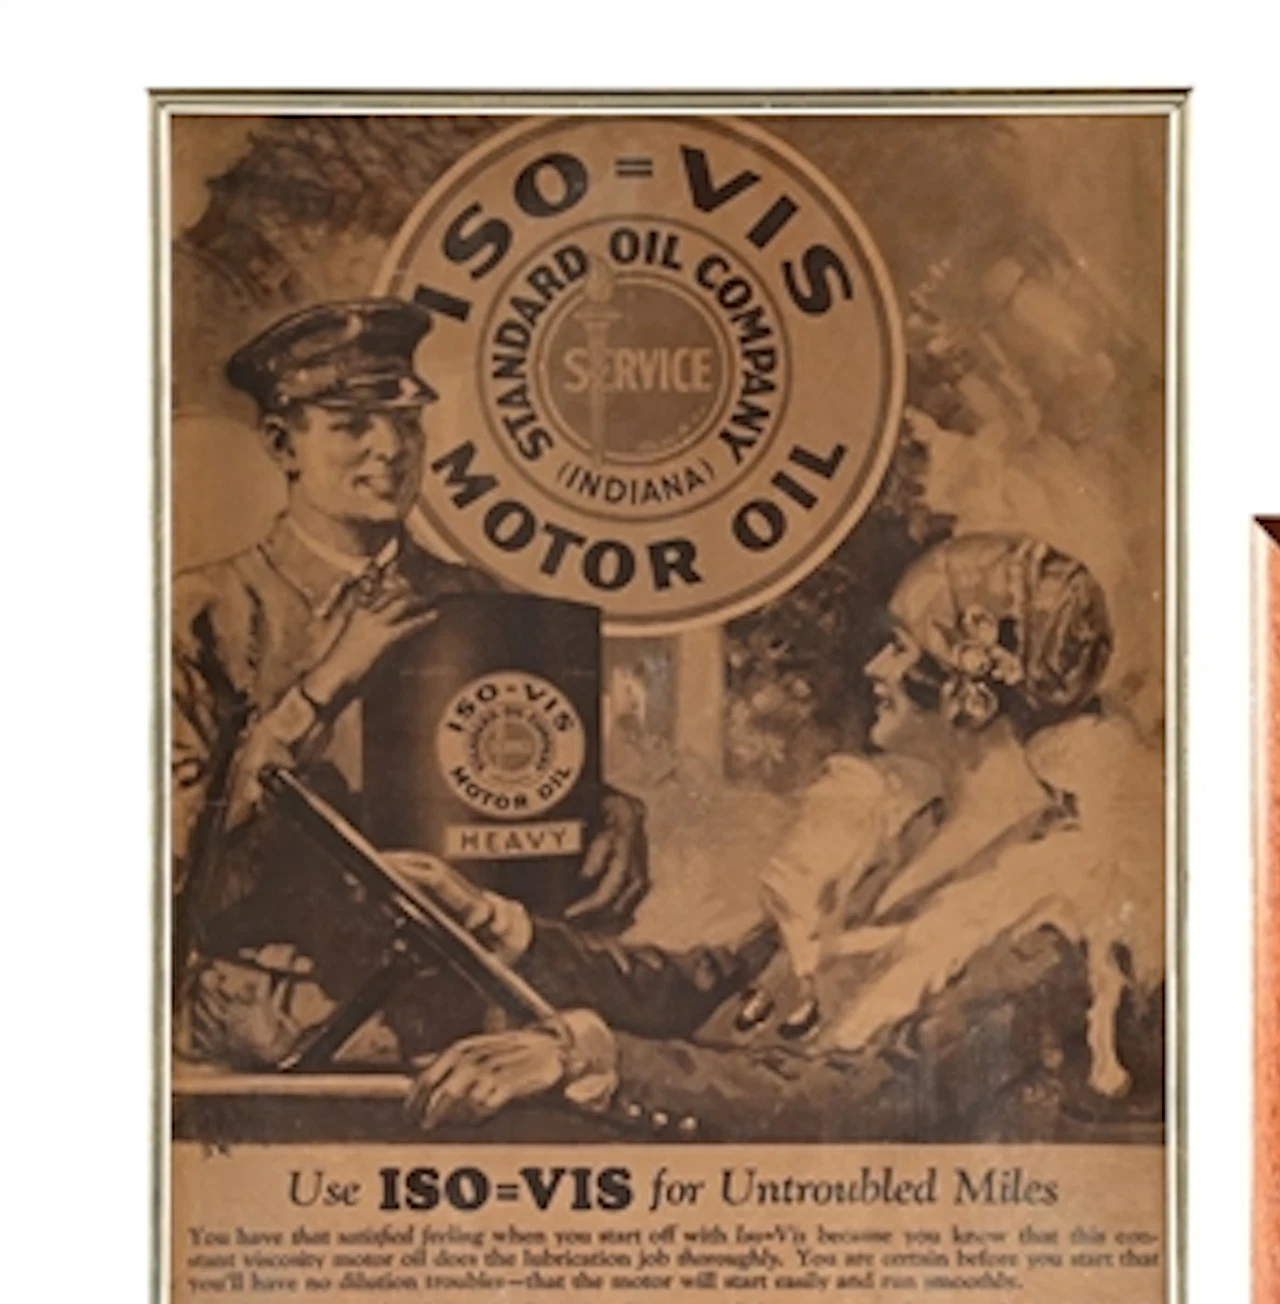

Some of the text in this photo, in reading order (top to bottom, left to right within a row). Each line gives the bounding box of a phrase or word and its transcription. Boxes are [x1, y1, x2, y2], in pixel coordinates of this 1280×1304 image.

[492, 228, 777, 465] STANDARD OIL COMPANY
[562, 347, 714, 395] SERVICE
[431, 441, 849, 591] MOTOR OIL
[451, 765, 571, 810] MOTOR OIL
[461, 828, 567, 851] HEAVY
[288, 1168, 361, 1208] Use
[648, 1167, 704, 1212] for
[719, 1166, 937, 1207] Untroubled
[953, 1168, 1059, 1205] Miles
